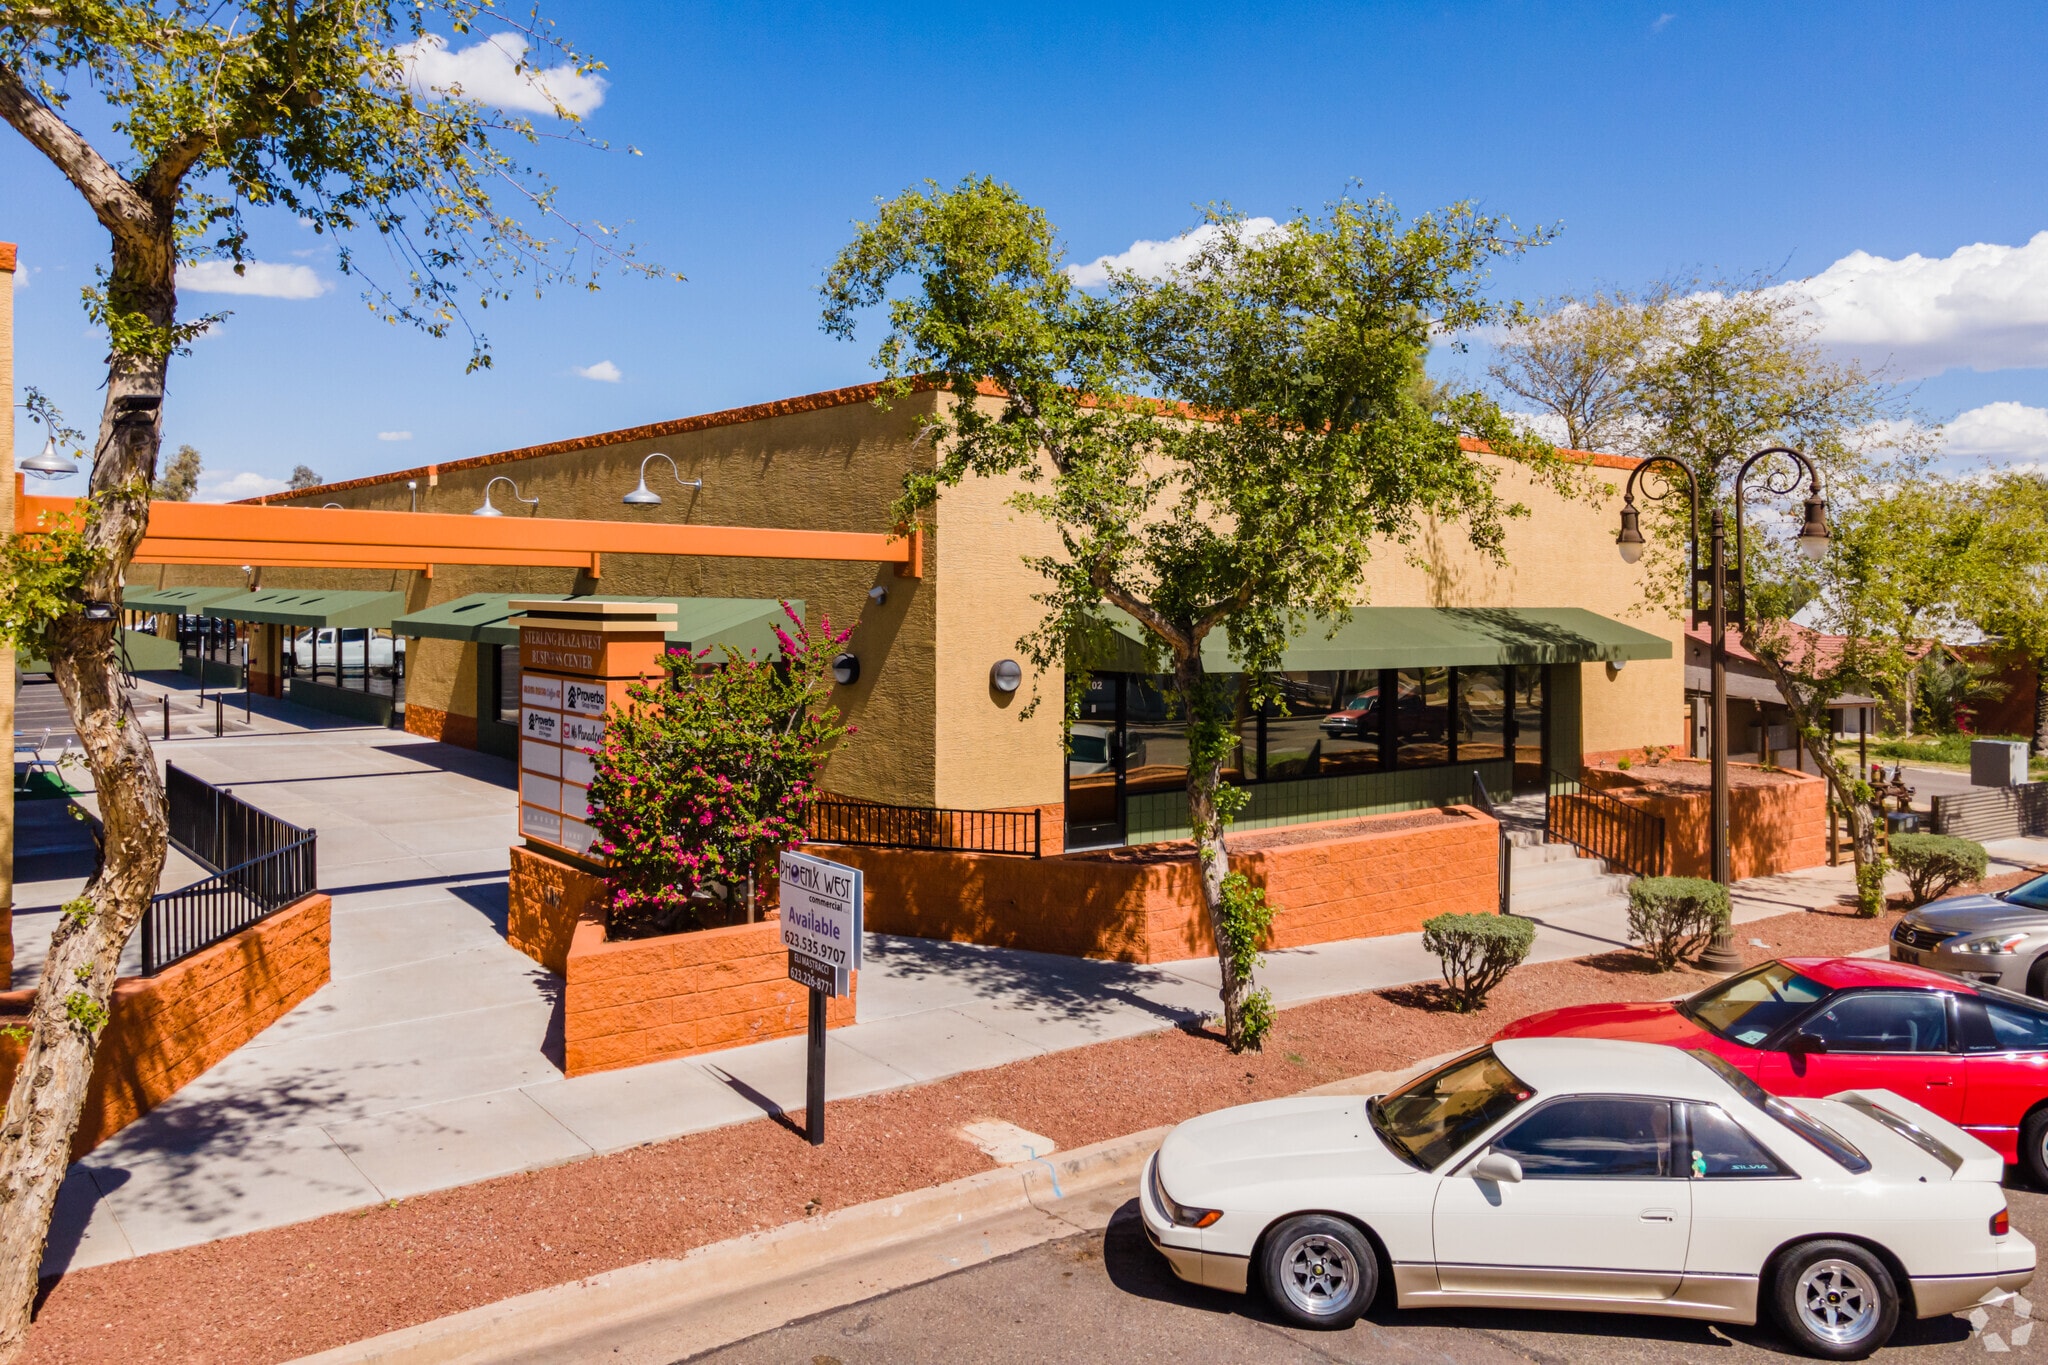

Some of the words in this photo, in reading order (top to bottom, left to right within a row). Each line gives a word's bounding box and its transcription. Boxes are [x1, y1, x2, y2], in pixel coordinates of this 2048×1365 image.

[524, 631, 557, 646] STERLING
[557, 633, 580, 648] PLAZA
[581, 635, 602, 650] WEST
[532, 650, 563, 666] BUSINESS
[563, 653, 593, 670] CENTER
[577, 687, 605, 705] Proverbs
[534, 714, 555, 727] Proverbs
[781, 860, 820, 891] PHOENIX
[824, 873, 851, 899] WEST
[809, 896, 843, 912] commercial
[789, 906, 840, 940] Available
[784, 930, 846, 965] 623.535.9707
